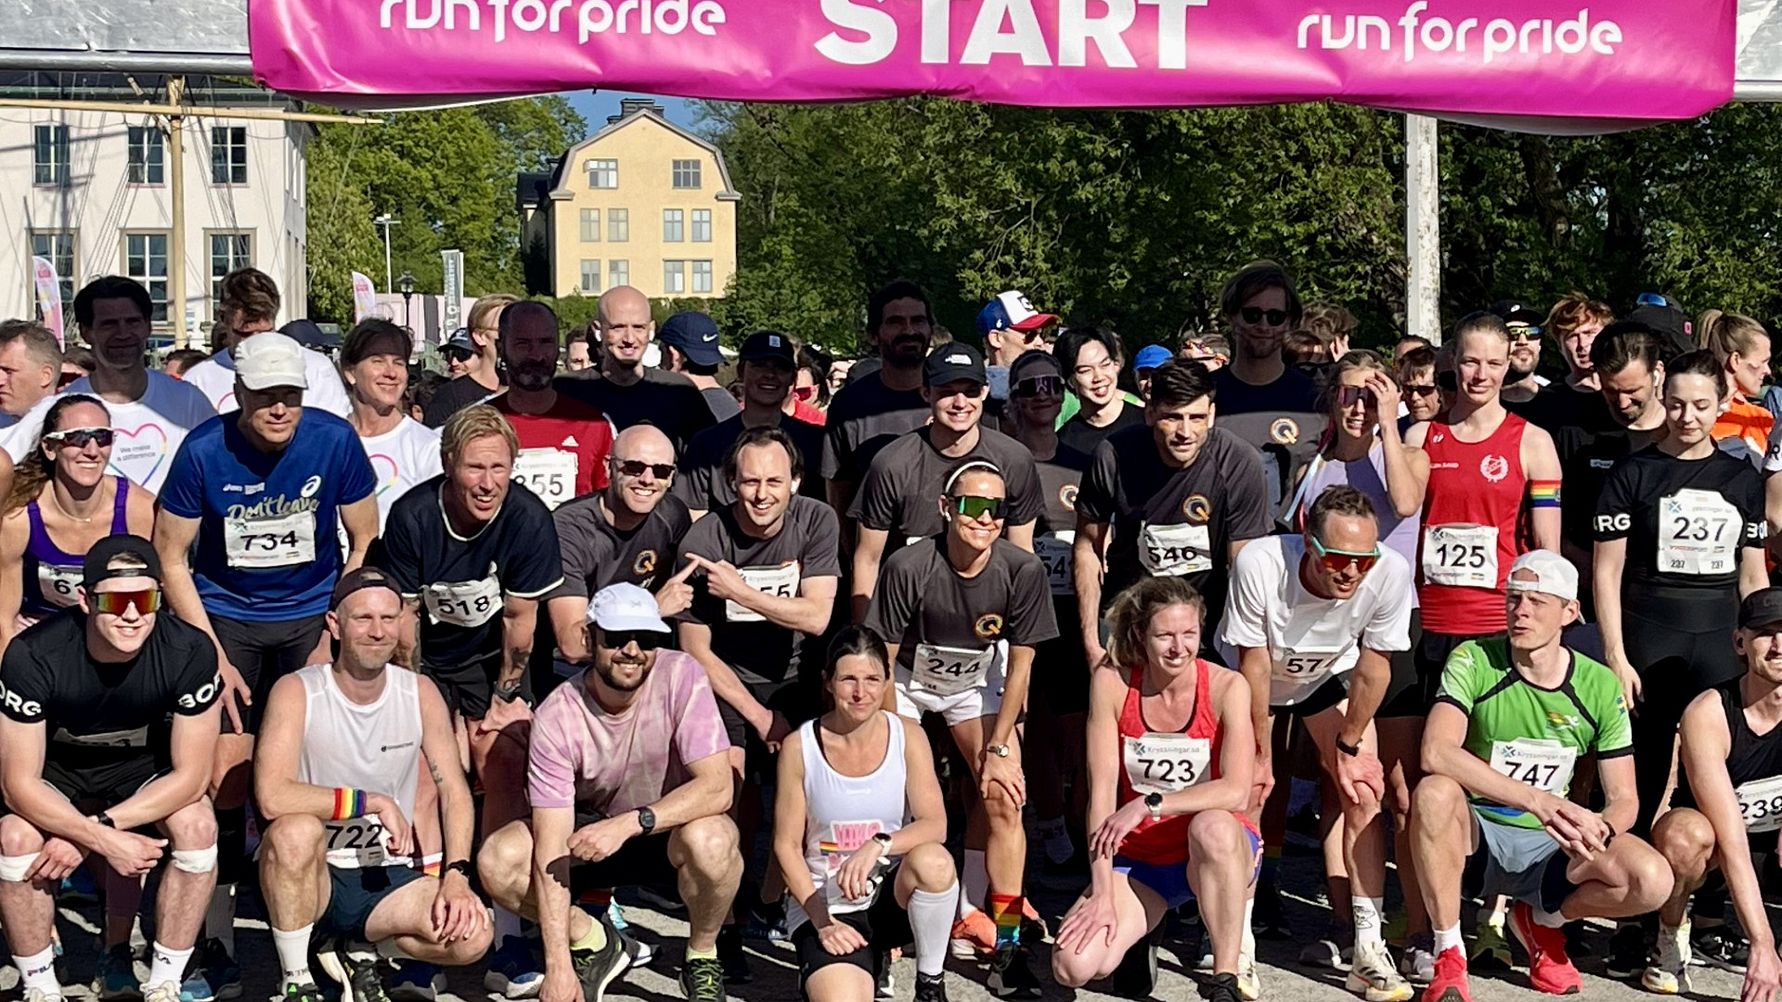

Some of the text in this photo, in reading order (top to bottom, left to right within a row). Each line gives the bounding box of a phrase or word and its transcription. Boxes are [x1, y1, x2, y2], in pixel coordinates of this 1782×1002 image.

[813, 0, 1208, 69] START
[1593, 513, 1631, 532] RG
[1673, 517, 1728, 542] 237
[240, 530, 299, 551] 734
[1040, 556, 1073, 578] 54
[1437, 544, 1485, 568] 125
[438, 596, 490, 615] 518
[928, 658, 980, 677] 244
[1138, 759, 1195, 783] 723
[1505, 761, 1559, 786] 747
[1739, 795, 1782, 818] 239
[325, 824, 383, 849] 722
